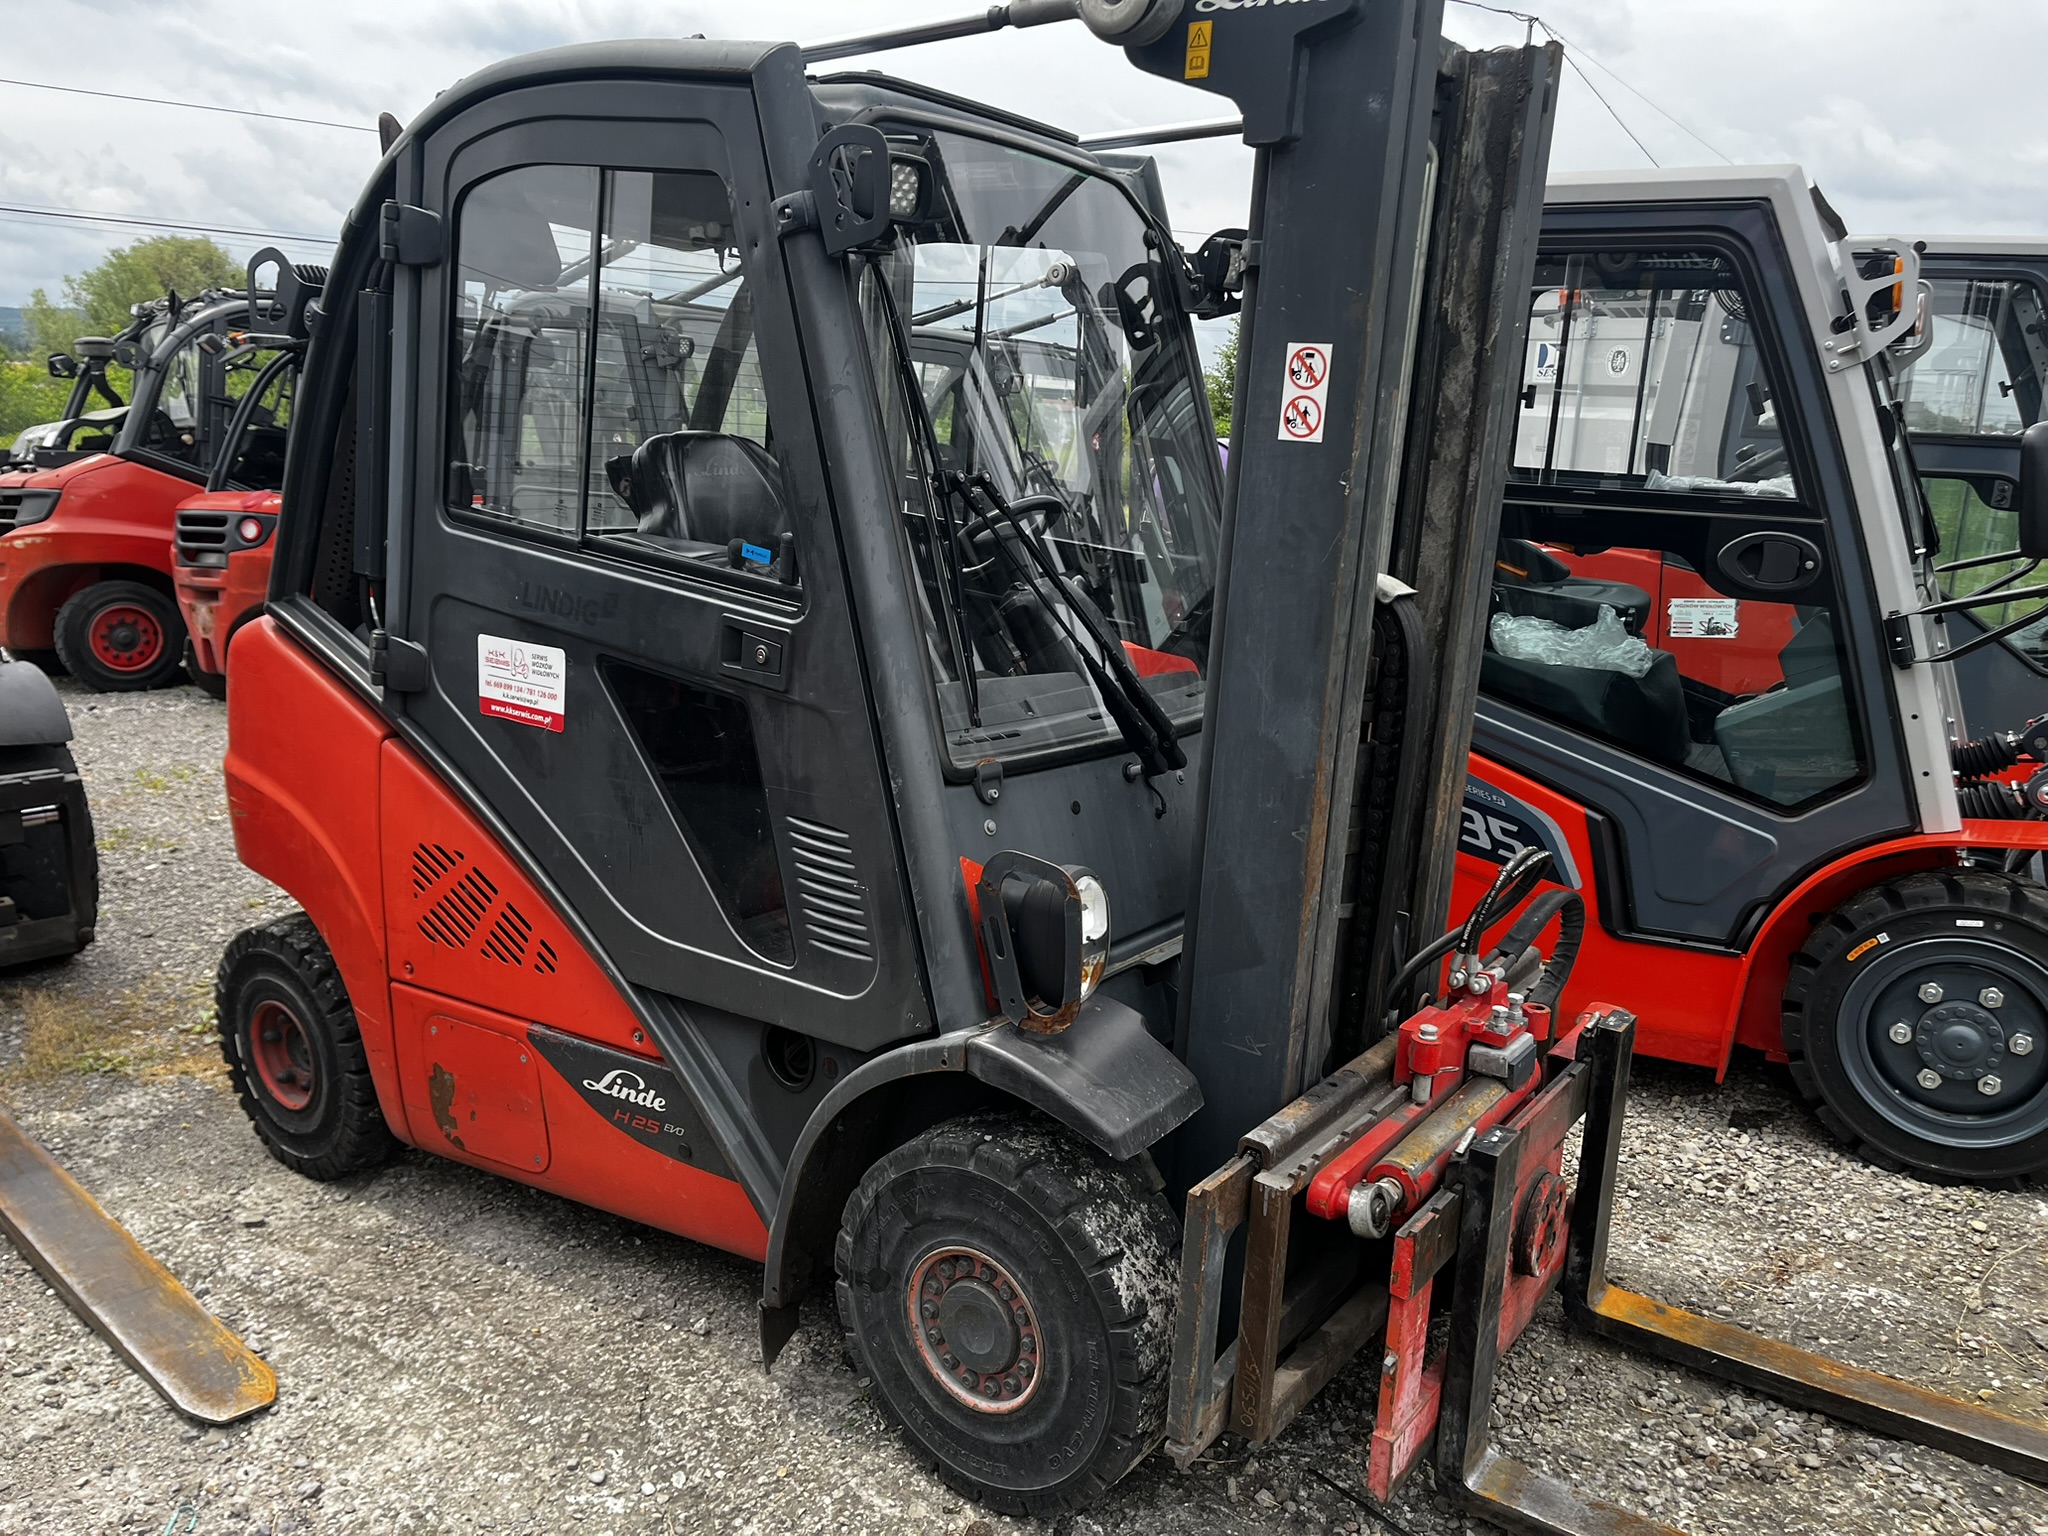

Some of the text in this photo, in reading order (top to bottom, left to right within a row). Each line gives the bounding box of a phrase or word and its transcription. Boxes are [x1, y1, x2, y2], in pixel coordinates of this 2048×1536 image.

[531, 653, 548, 662] SERWIS
[490, 704, 552, 725] www.kkserwis.com.pl
[582, 1069, 667, 1112] Linde
[663, 1123, 685, 1136] EVO
